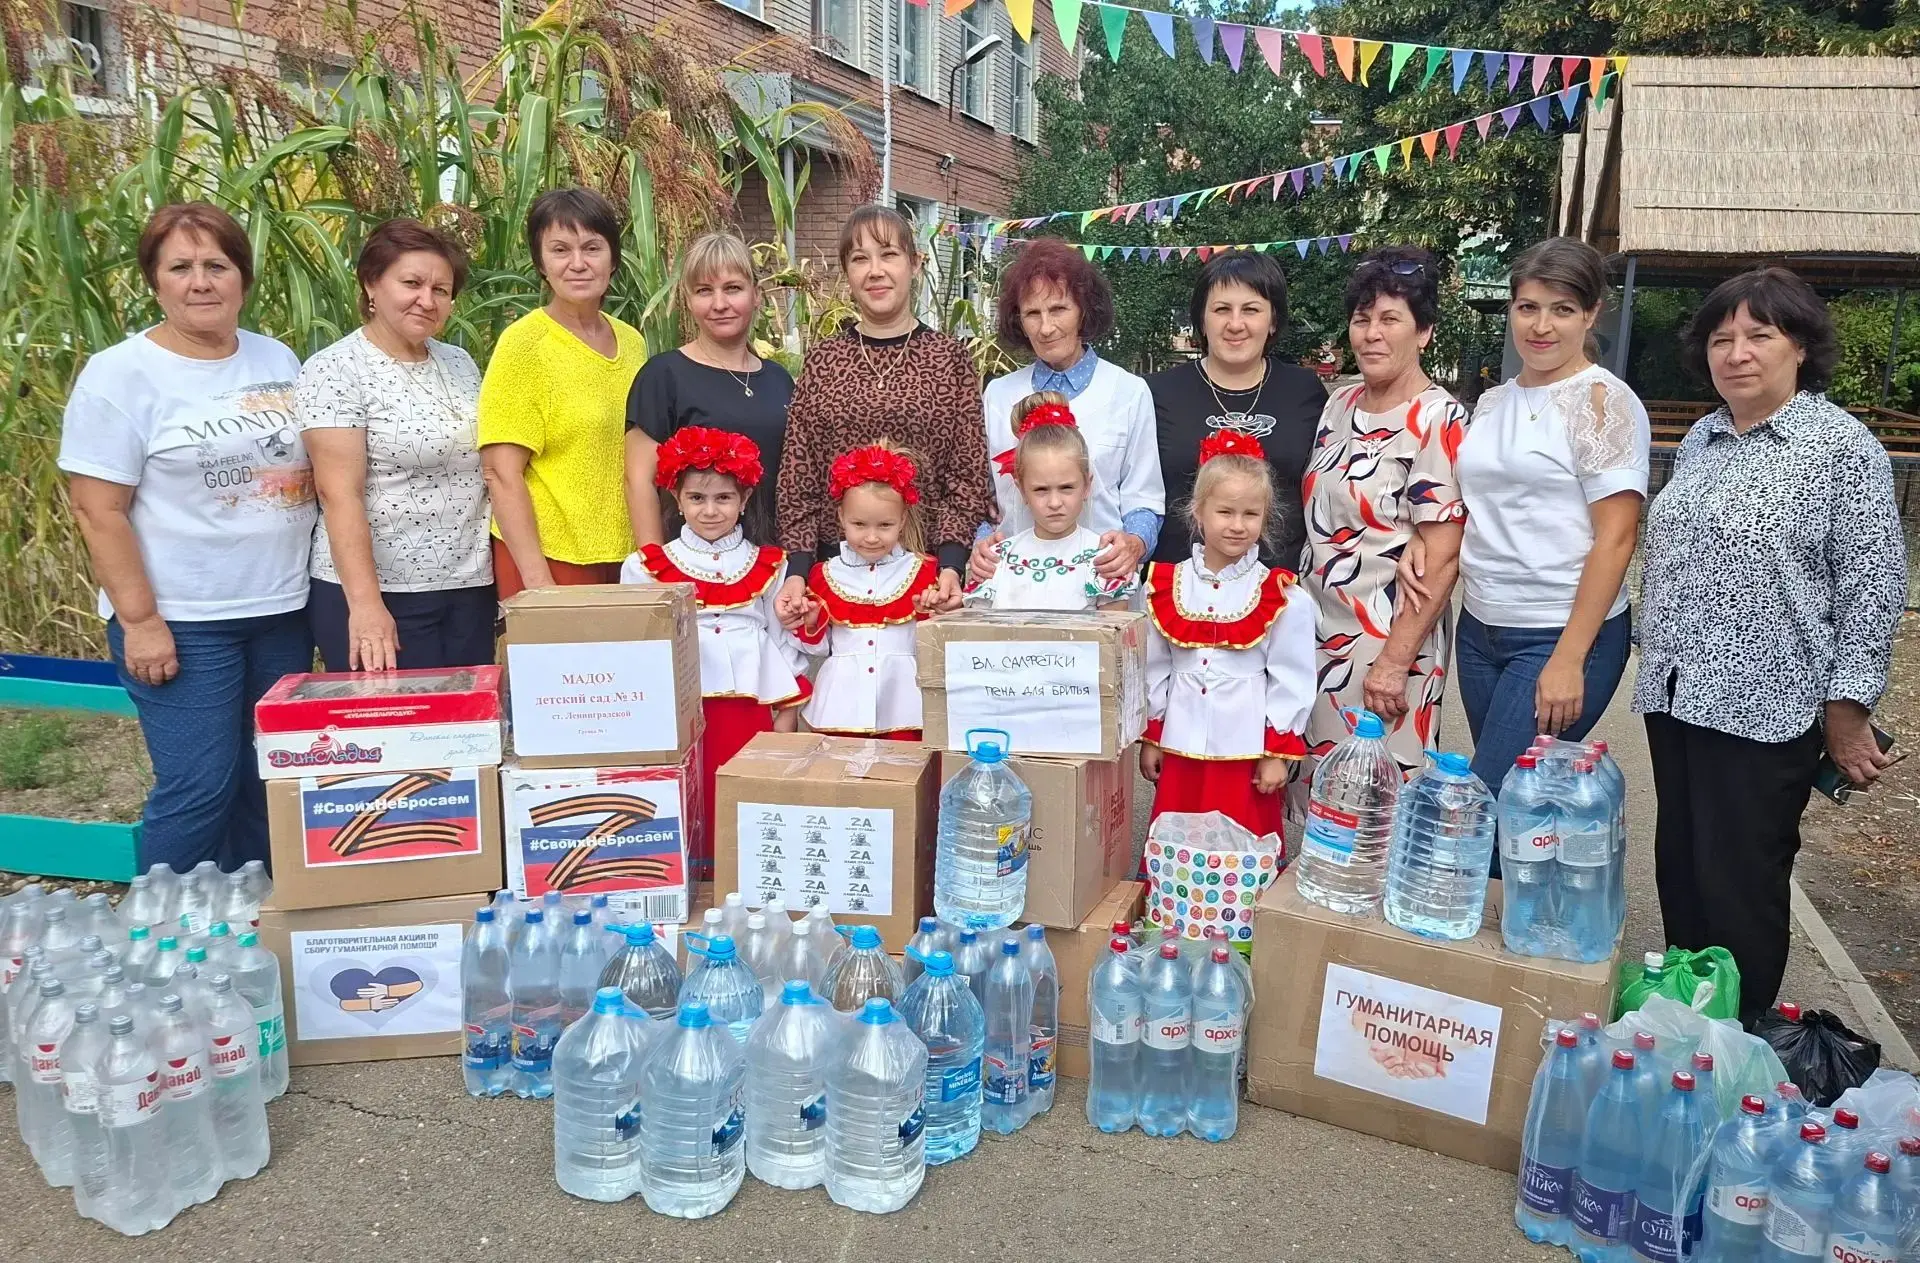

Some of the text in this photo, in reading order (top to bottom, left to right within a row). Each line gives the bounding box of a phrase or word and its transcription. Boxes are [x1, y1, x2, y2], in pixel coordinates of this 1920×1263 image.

[220, 452, 254, 466] FEELING
[204, 466, 253, 489] GOOD
[971, 654, 1076, 670] ВЛ. САЛФЕТКИ
[562, 672, 616, 685] МАДОУ
[1021, 685, 1045, 697] ДЛЯ
[1051, 685, 1091, 697] БРИТЬЯ
[535, 690, 645, 706] детский сад № 31
[551, 710, 632, 721] ст. Ленинградской
[312, 794, 470, 816] #СвоихНеБросаем
[761, 811, 783, 822] ZA
[806, 814, 828, 825] ZA
[850, 817, 872, 828] ZA
[529, 831, 675, 851] #СвоихНеБросаем
[761, 844, 782, 855] ZA
[805, 847, 827, 858] ZA
[849, 850, 871, 861] ZA
[760, 876, 782, 887] ZA
[804, 879, 826, 890] ZA
[848, 882, 870, 893] ZA
[306, 933, 439, 946] БЛАГОТВОРИТЕЛЬНАЯ АКЦИЯ ПО
[304, 941, 438, 955] СБОРУ ГУМАНИТАРНОЙ ПОМОЩИ
[1336, 989, 1494, 1048] ГУМАНИТАРНАЯ
[1364, 1022, 1456, 1062] ПОМОЩЬ
[209, 1044, 246, 1065] анай
[1641, 1220, 1688, 1241] СУНА
